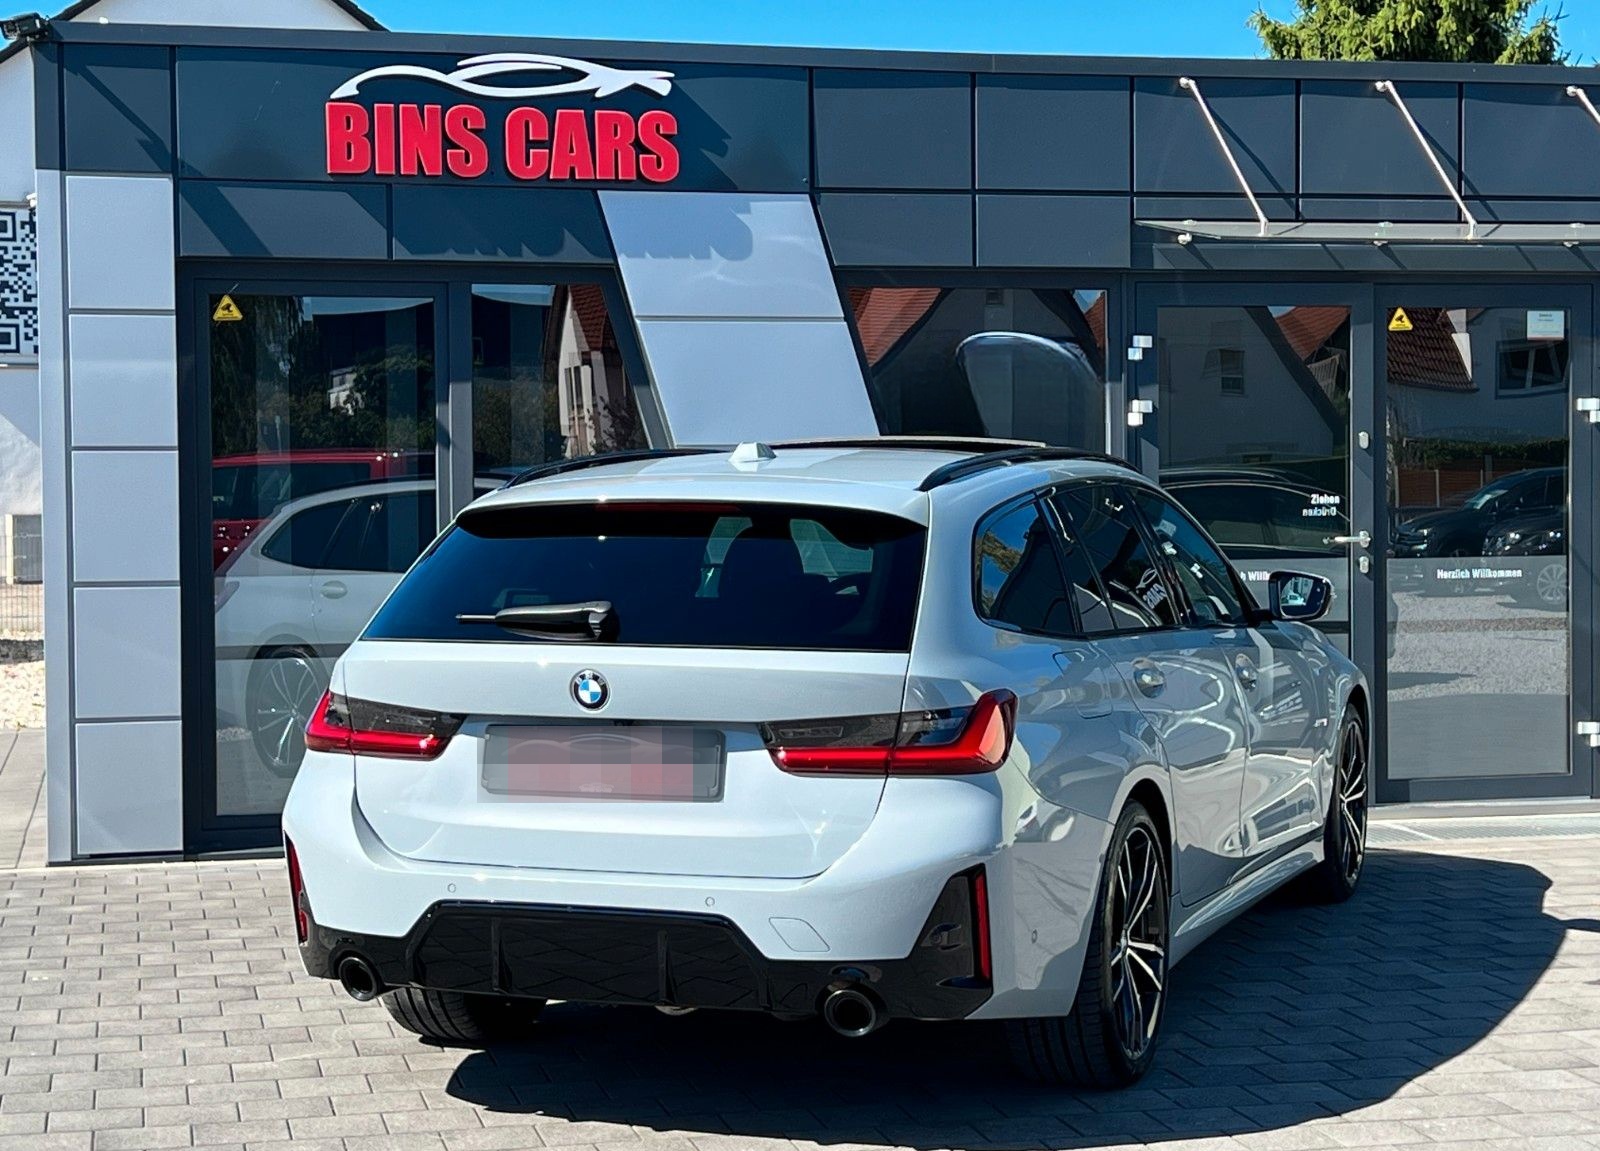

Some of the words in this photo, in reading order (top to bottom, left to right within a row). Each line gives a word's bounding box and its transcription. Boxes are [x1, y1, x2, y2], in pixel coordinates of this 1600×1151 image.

[325, 102, 488, 178] BINS
[504, 107, 680, 182] CARS
[1310, 493, 1340, 504] Ziehen
[1436, 568, 1470, 579] Herzlich
[1471, 568, 1523, 579] Willkommen
